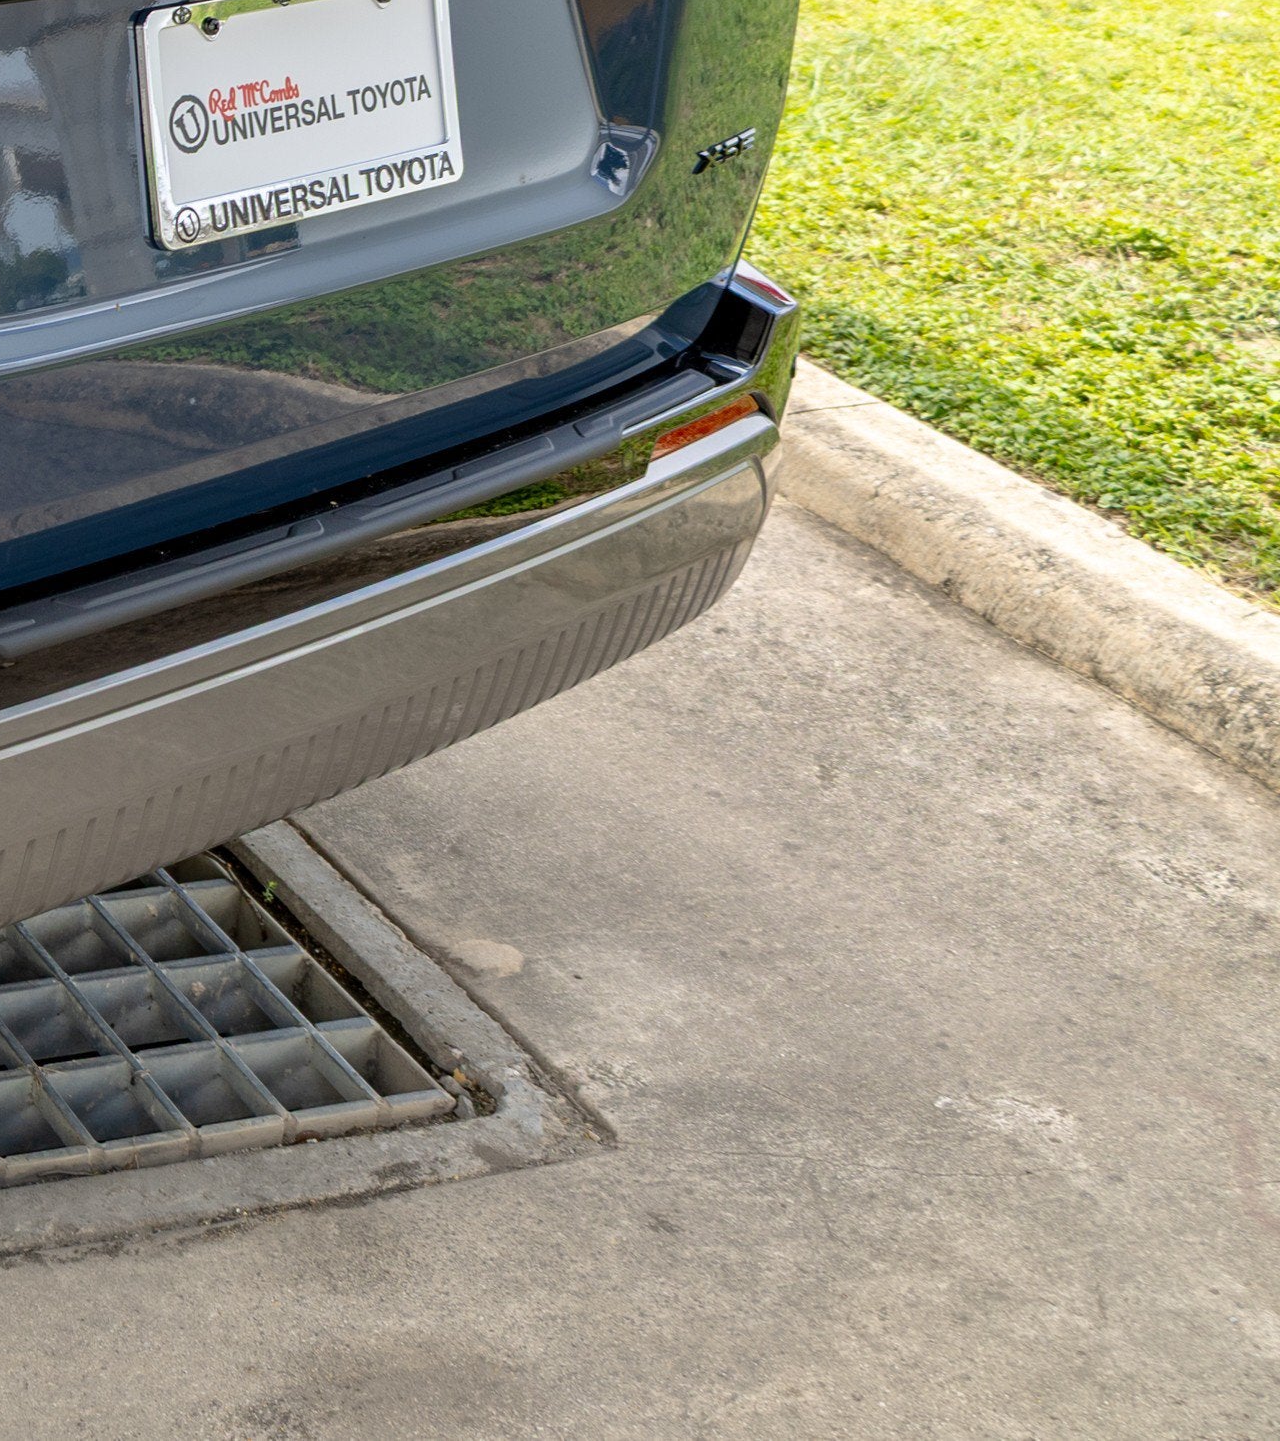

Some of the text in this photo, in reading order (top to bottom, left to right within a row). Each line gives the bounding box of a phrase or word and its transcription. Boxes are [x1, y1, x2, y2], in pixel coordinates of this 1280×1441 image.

[208, 76, 300, 121] Red McCombs
[212, 75, 432, 146] UNIVERSAL TOYOTA
[209, 151, 455, 232] UNIVERSAL TOYOTA
